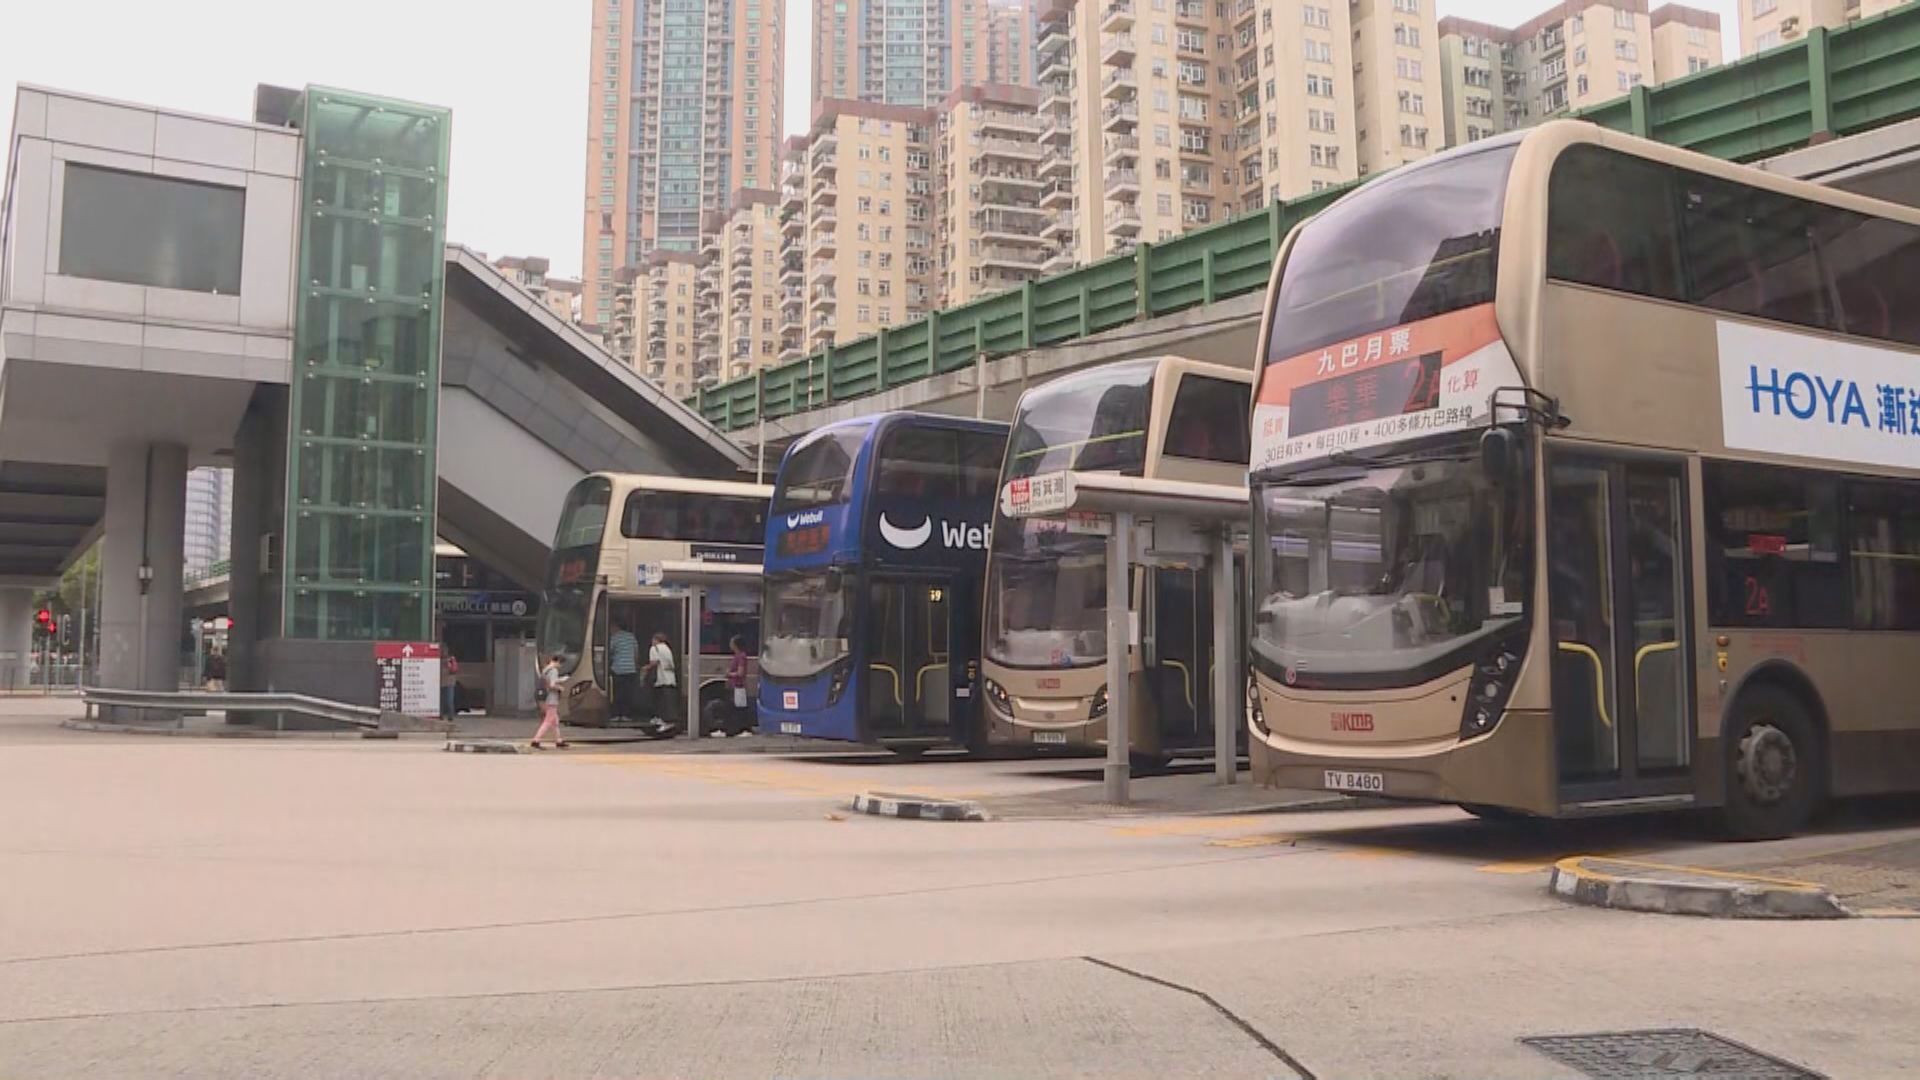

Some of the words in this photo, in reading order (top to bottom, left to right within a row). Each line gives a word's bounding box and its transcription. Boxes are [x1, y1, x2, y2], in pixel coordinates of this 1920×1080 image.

[1317, 329, 1410, 375] 九巴月票
[1447, 367, 1480, 394] 化算
[1745, 364, 1870, 428] HOYA
[1374, 404, 1473, 437] 400多條九巴路線
[1343, 713, 1375, 731] KMB
[1327, 772, 1342, 787] TV
